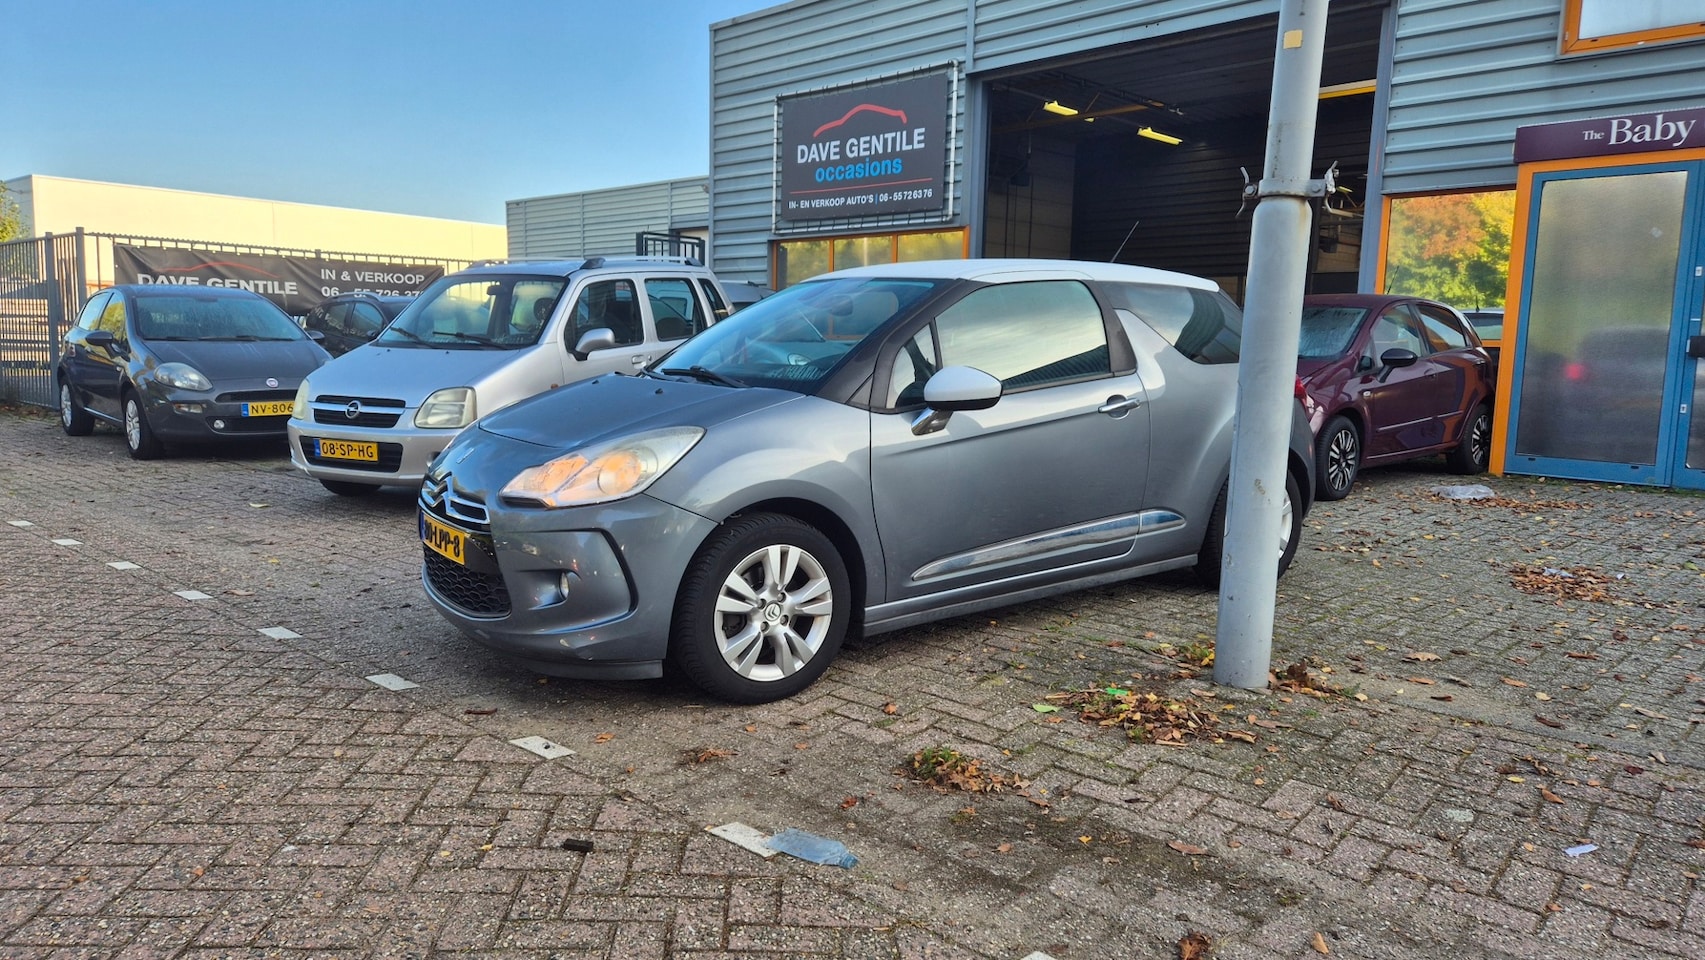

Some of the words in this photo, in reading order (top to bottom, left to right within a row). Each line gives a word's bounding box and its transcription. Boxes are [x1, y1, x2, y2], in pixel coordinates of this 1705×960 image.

[1582, 130, 1605, 140] The
[1608, 114, 1697, 147] Baby
[797, 140, 841, 164] DAVE
[846, 127, 926, 158] GENTILE
[815, 157, 903, 183] occasions
[800, 200, 810, 208] EN
[811, 198, 845, 208] VERKOOP
[846, 194, 874, 205] AUTO'S
[137, 273, 200, 286] DAVE
[207, 277, 299, 295] GENTILE
[321, 269, 336, 280] IN
[341, 270, 351, 281] &
[355, 271, 425, 285] VERKOOP
[321, 286, 340, 297] 06
[321, 442, 374, 458] 08-SP-HG
